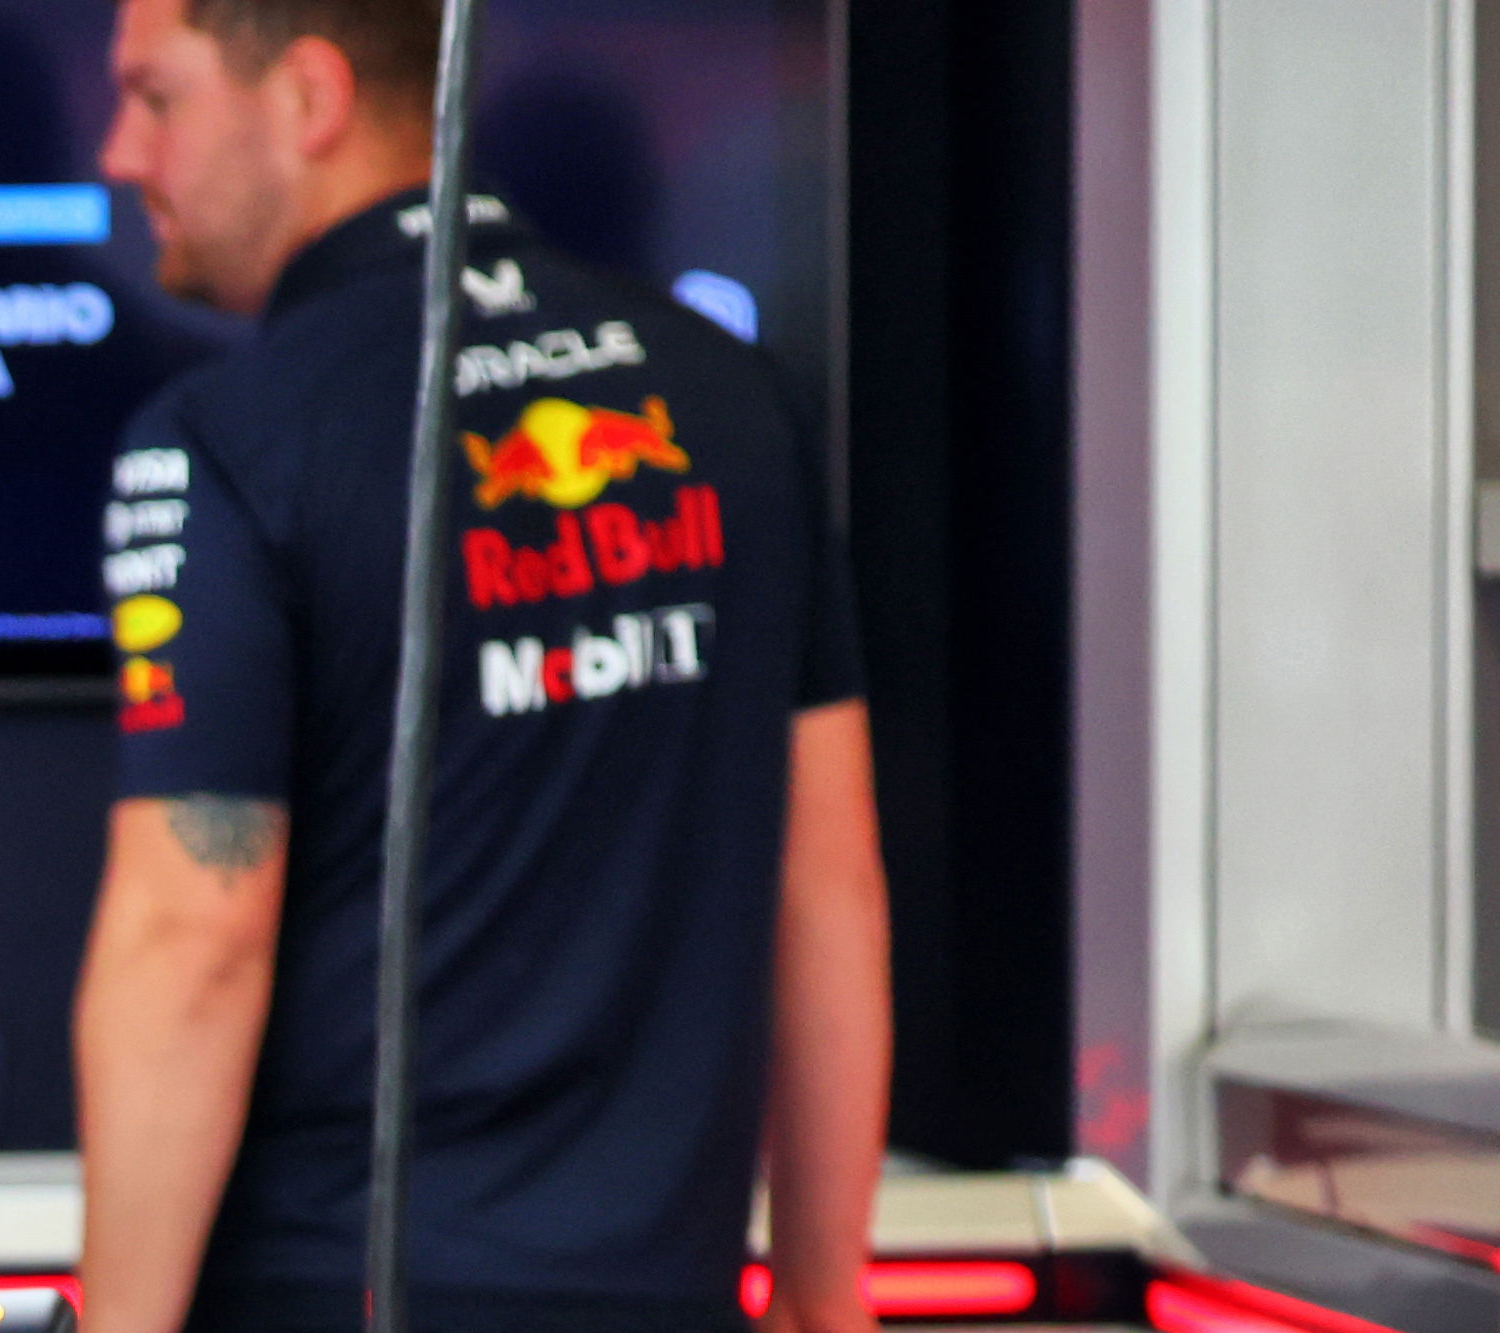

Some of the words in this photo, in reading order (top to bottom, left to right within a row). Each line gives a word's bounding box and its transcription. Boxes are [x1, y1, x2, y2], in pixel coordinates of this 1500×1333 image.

[457, 322, 646, 396] RACLE
[462, 510, 593, 610] Red
[587, 484, 724, 586] Bull
